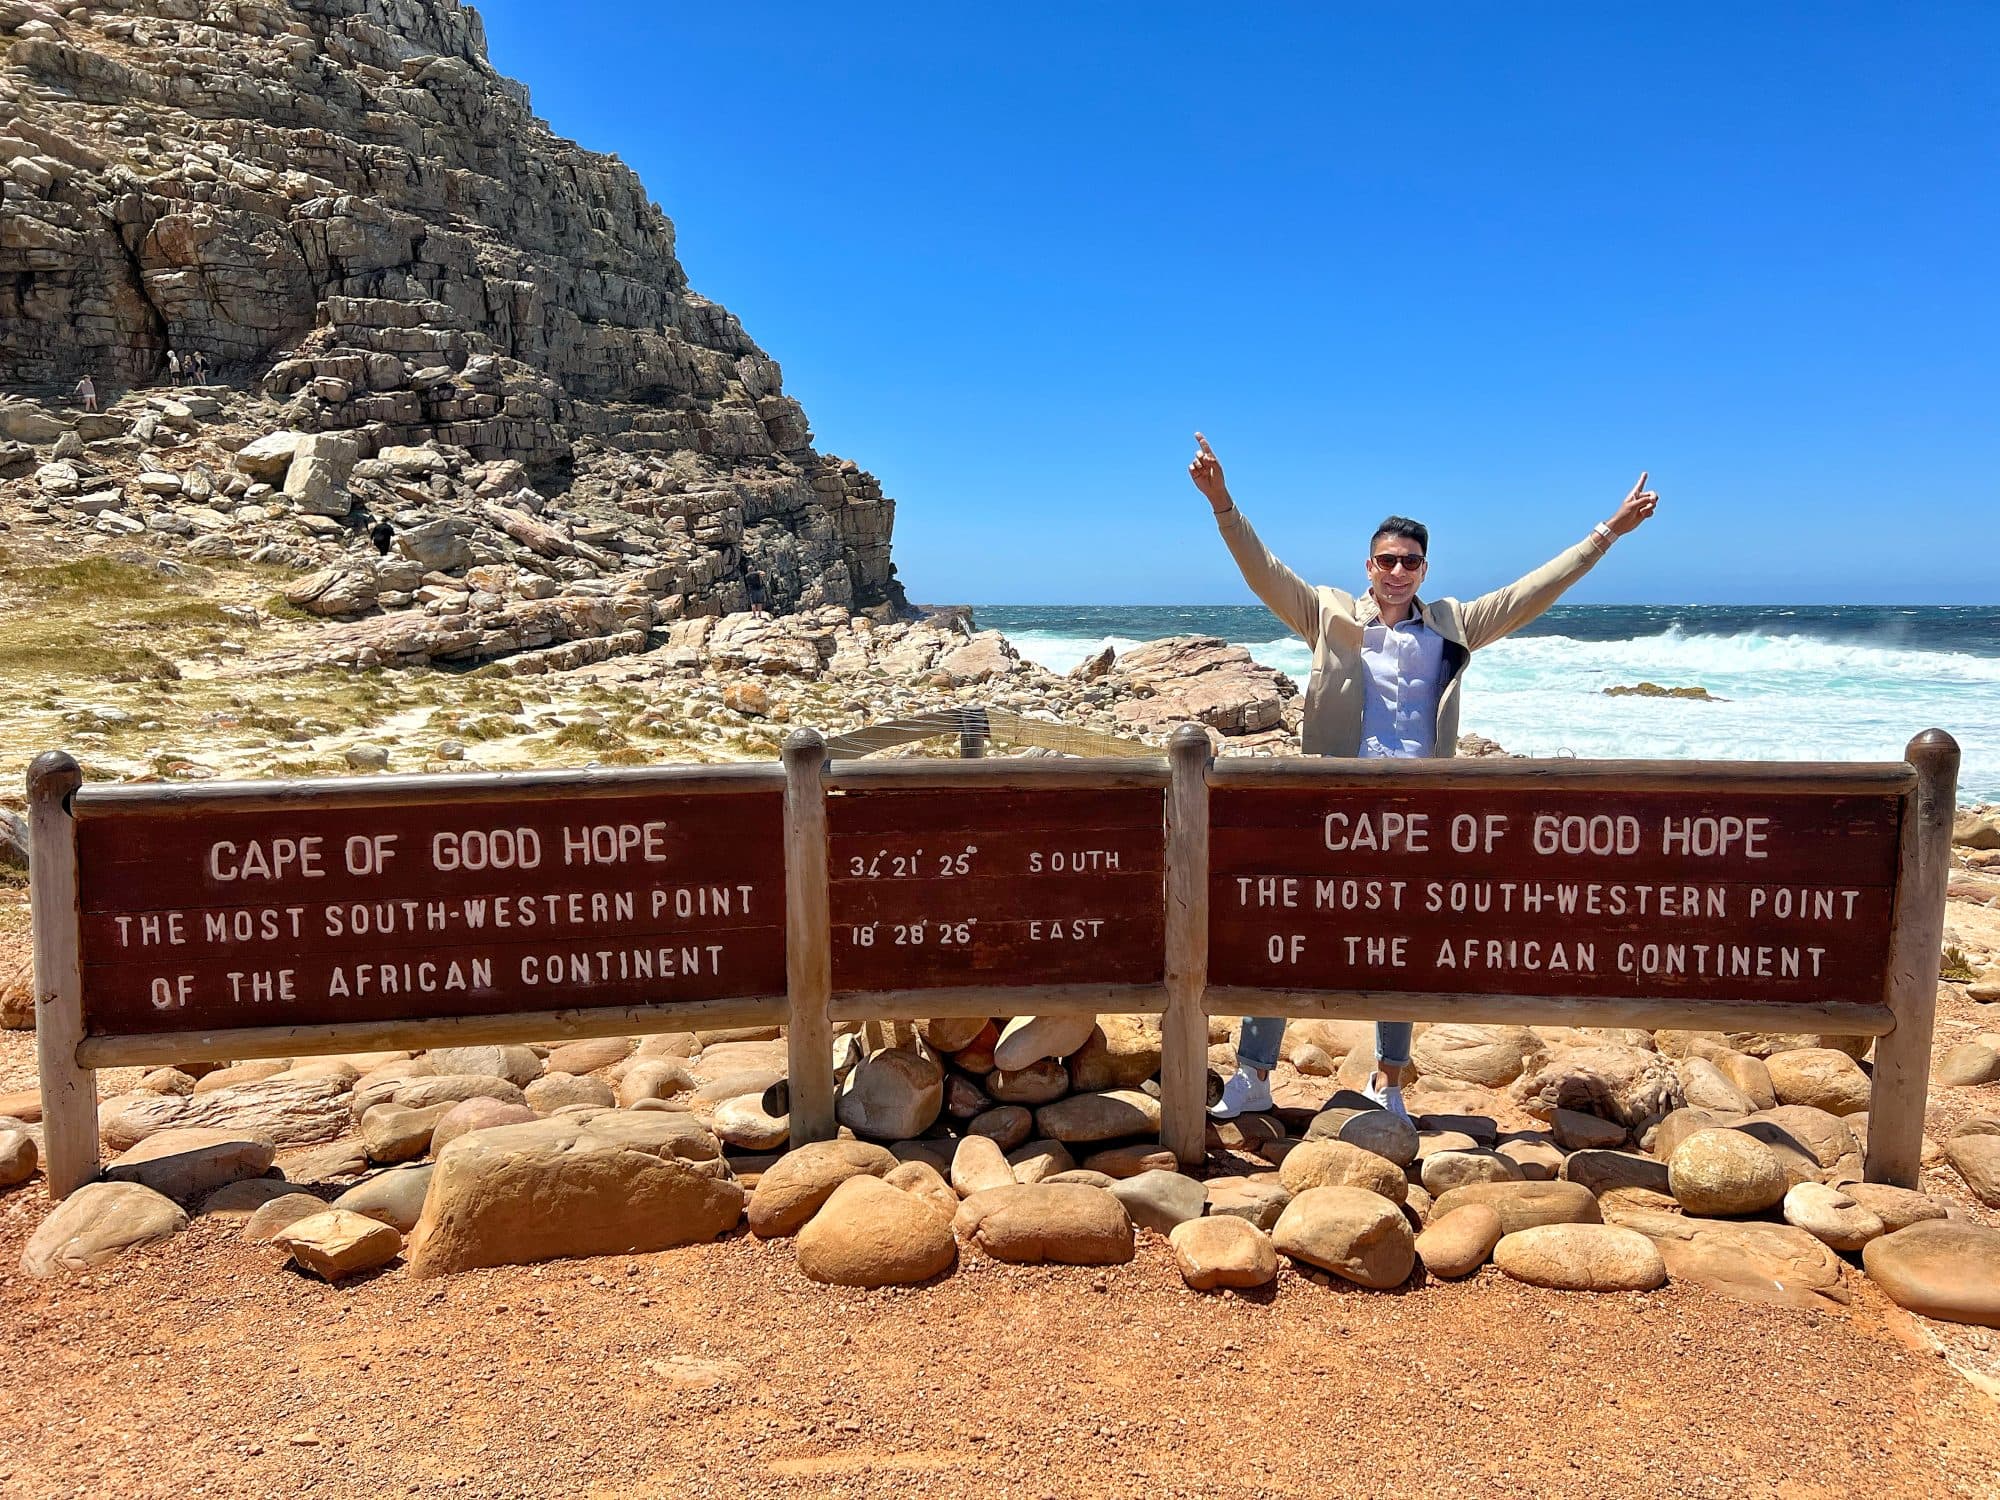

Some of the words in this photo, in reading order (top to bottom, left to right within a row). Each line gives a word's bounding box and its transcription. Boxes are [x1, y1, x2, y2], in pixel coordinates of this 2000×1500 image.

[211, 836, 325, 881] CAPE
[345, 834, 398, 875] OF
[432, 827, 541, 871] GOOD
[563, 821, 667, 865] HOPE
[1325, 812, 1429, 852] CAPE
[1451, 813, 1508, 853] OF
[1533, 814, 1640, 856] GOOD
[1662, 816, 1770, 858] HOPE
[1029, 850, 1119, 873] SOUTH
[114, 913, 186, 947] THE
[205, 908, 304, 942] MOST
[325, 891, 634, 937] SOUTH-WESTERN
[652, 885, 753, 918] POINT
[1236, 877, 1298, 907] THE
[1316, 879, 1407, 911] MOST
[1425, 882, 1726, 918] SOUTH-WESTERN
[1750, 887, 1860, 920] POINT
[1030, 919, 1105, 940] EAST
[151, 975, 194, 1009] OF
[226, 969, 296, 1002] THE
[329, 958, 492, 997] AFRICAN
[521, 945, 723, 985] CONTINENT
[1268, 934, 1306, 964] OF
[1343, 936, 1408, 967] THE
[1436, 938, 1595, 972] AFRICAN
[1617, 942, 1826, 978] CONTINENT
